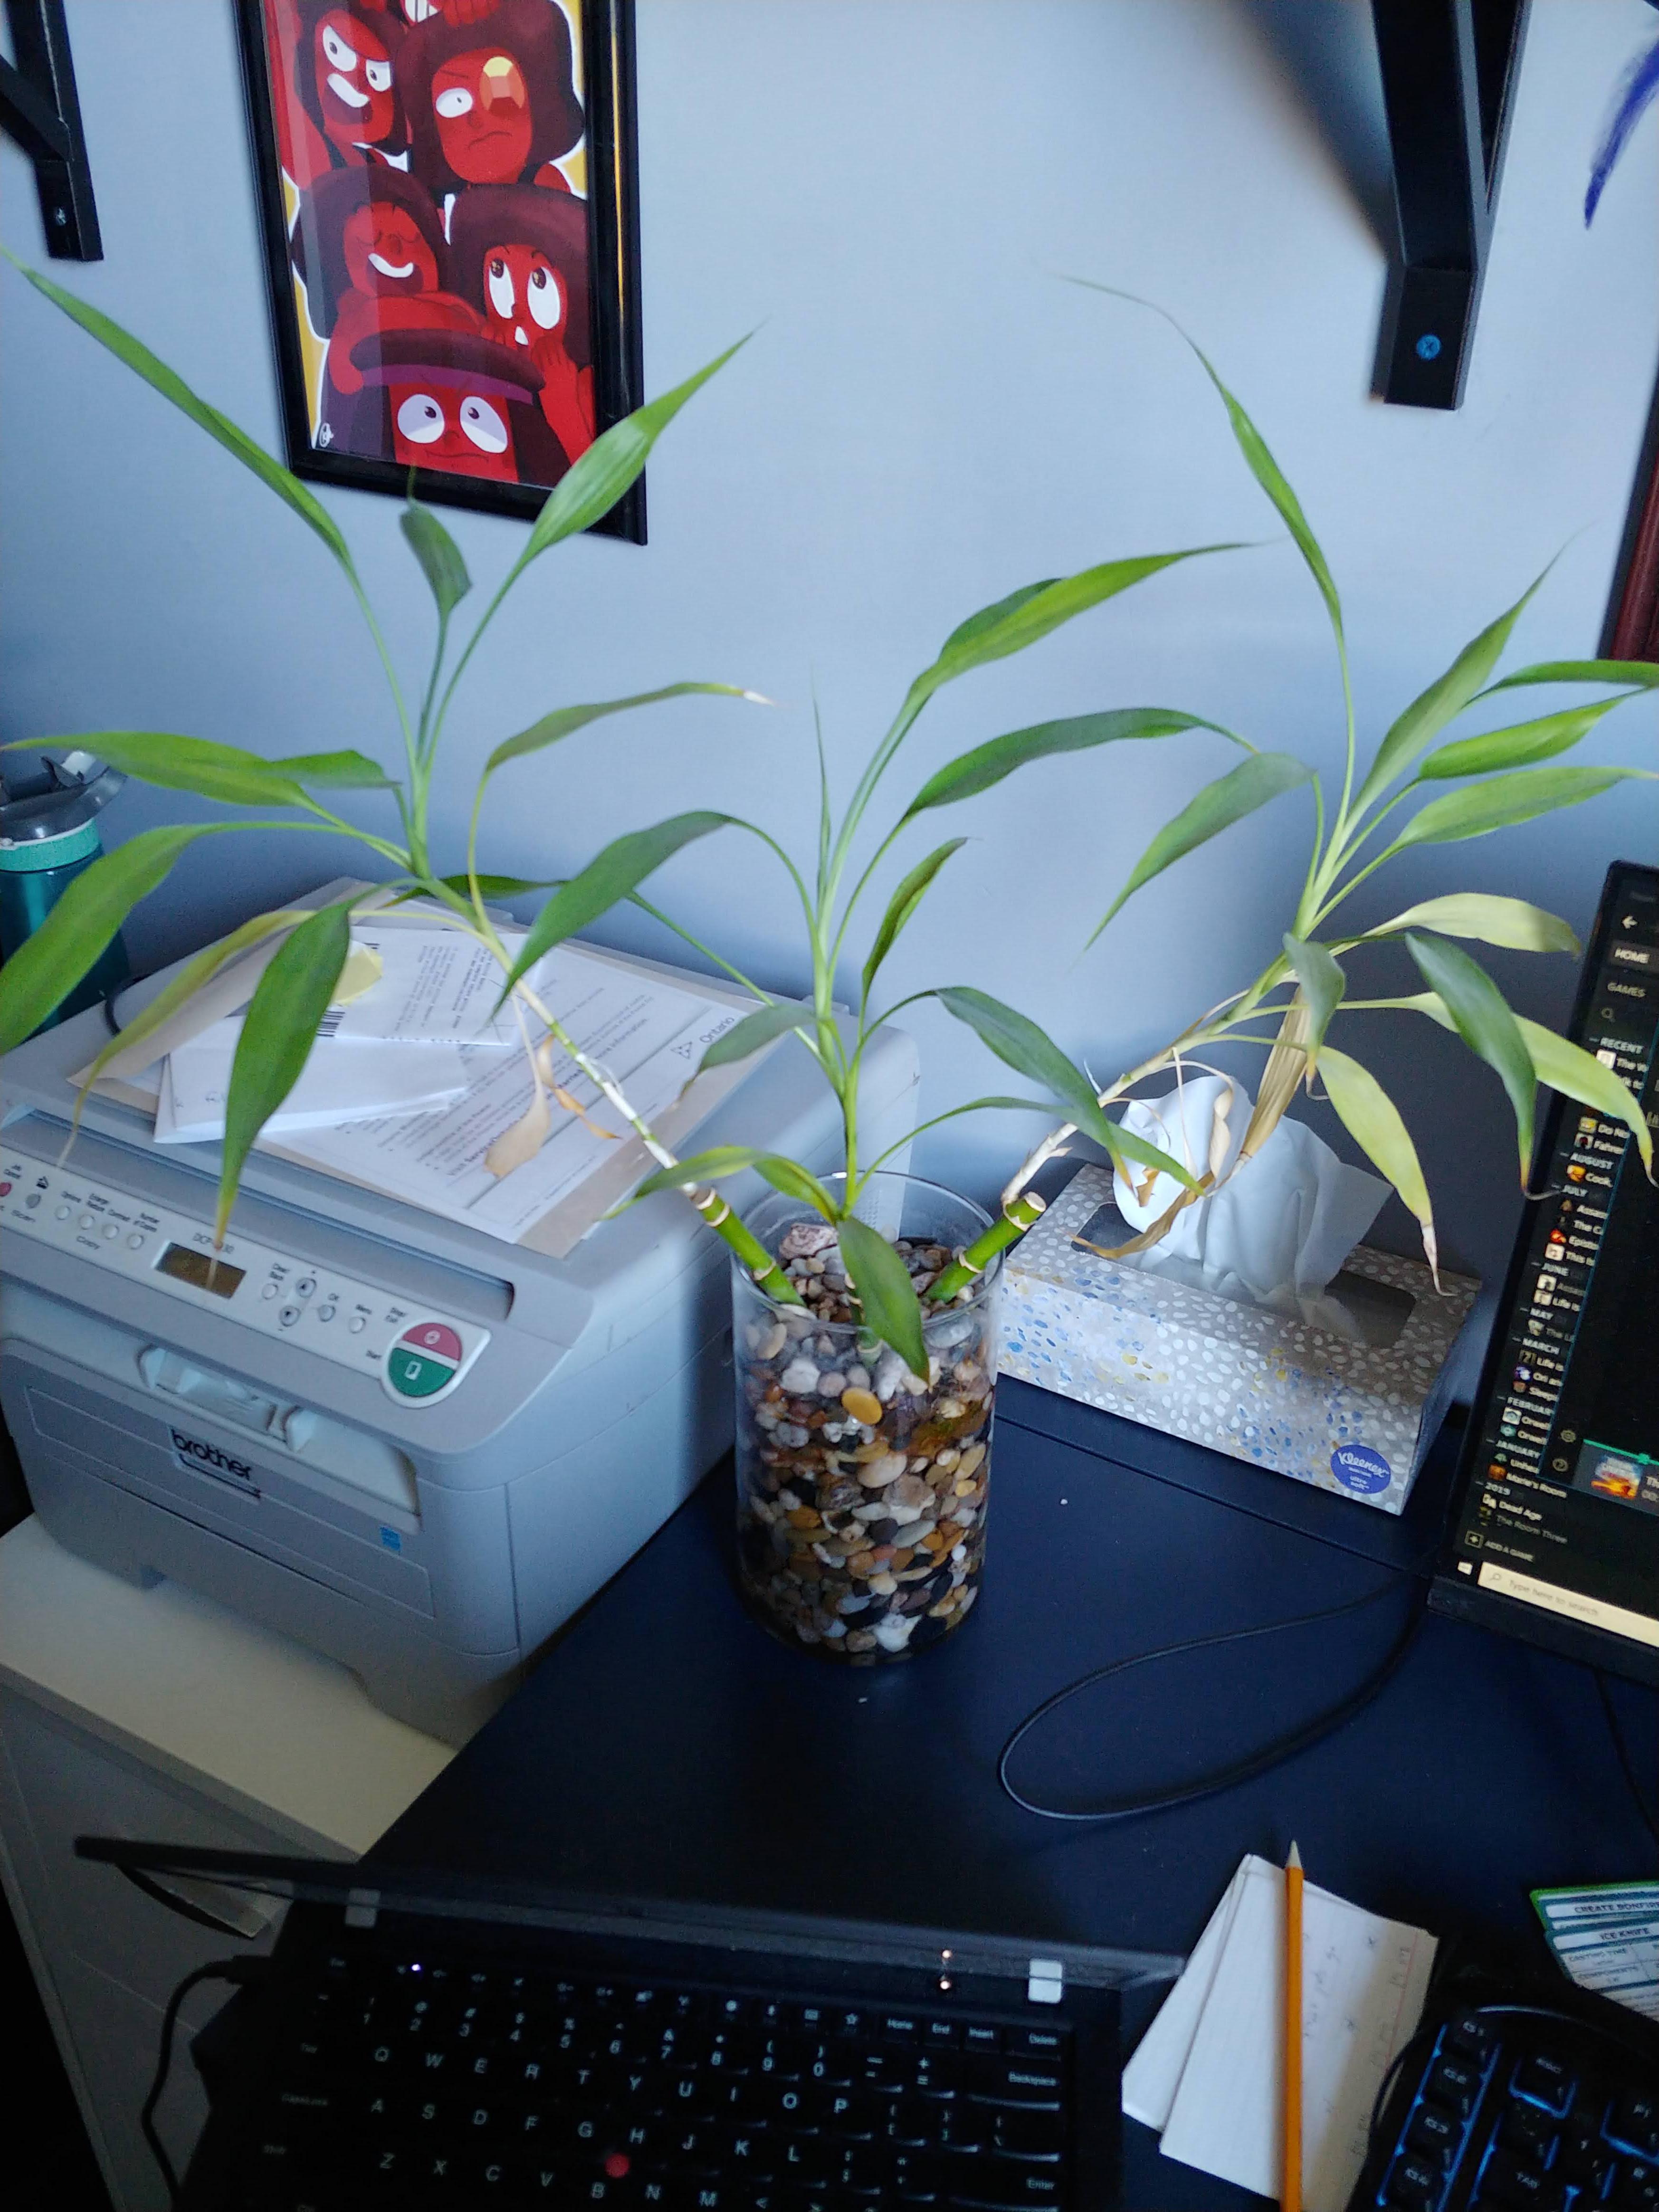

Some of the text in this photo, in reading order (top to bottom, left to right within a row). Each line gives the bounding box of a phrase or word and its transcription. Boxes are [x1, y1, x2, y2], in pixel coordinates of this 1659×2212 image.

[1615, 948, 1650, 963] HOME
[1608, 982, 1646, 998] GAMES
[699, 1017, 734, 1043] Ontario
[1601, 1038, 1643, 1054] RECENT
[1570, 1152, 1614, 1169] AUGUST
[1562, 1184, 1588, 1197] JULY
[10, 1210, 36, 1223] Scan
[76, 1236, 100, 1250] Copy
[1542, 1263, 1569, 1277] JUNE
[1530, 1307, 1554, 1321] MAY
[1522, 1338, 1560, 1355] MARCH
[171, 1428, 252, 1480] brother
[1496, 1440, 1541, 1459] JANUARY
[1337, 1452, 1390, 1478] Kleenex
[1539, 1483, 1567, 1498] Room
[1499, 1501, 1543, 1521] Dead Age
[1514, 1521, 1541, 1535] Room
[1485, 1541, 1534, 1562] ADD A GAME
[1510, 1580, 1530, 1594] Type
[1533, 1588, 1553, 1599] here
[1570, 1601, 1598, 1616] search
[1574, 1904, 1614, 1913] CREATE
[1599, 1927, 1649, 1941] ICE KNIFE
[410, 2018, 421, 2031] 2
[459, 2023, 470, 2037] 3
[887, 2018, 914, 2031] Home
[932, 2022, 951, 2034] End
[560, 2034, 570, 2048] 5
[610, 2040, 620, 2054] 6
[426, 2053, 443, 2068] W
[475, 2058, 487, 2073] E
[579, 2069, 590, 2084] T
[813, 2062, 824, 2077] 0
[629, 2076, 641, 2090] Y
[1007, 2070, 1058, 2087] Backspace
[679, 2082, 693, 2097] U
[730, 2087, 736, 2101] I
[371, 2099, 383, 2112] A
[782, 2093, 798, 2109] O
[834, 2098, 848, 2113] P
[422, 2104, 435, 2119] S
[525, 2116, 538, 2130] F
[578, 2121, 592, 2137] G
[629, 2128, 644, 2144] H
[682, 2135, 695, 2150] J
[735, 2140, 749, 2155] K
[788, 2145, 799, 2162] L
[380, 2153, 395, 2169] Z
[434, 2160, 447, 2175] X
[486, 2165, 501, 2181] C
[541, 2173, 553, 2187] V
[591, 2182, 605, 2199] B
[1026, 2176, 1056, 2191] Enter
[646, 2184, 661, 2200] N
[699, 2191, 717, 2206] M
